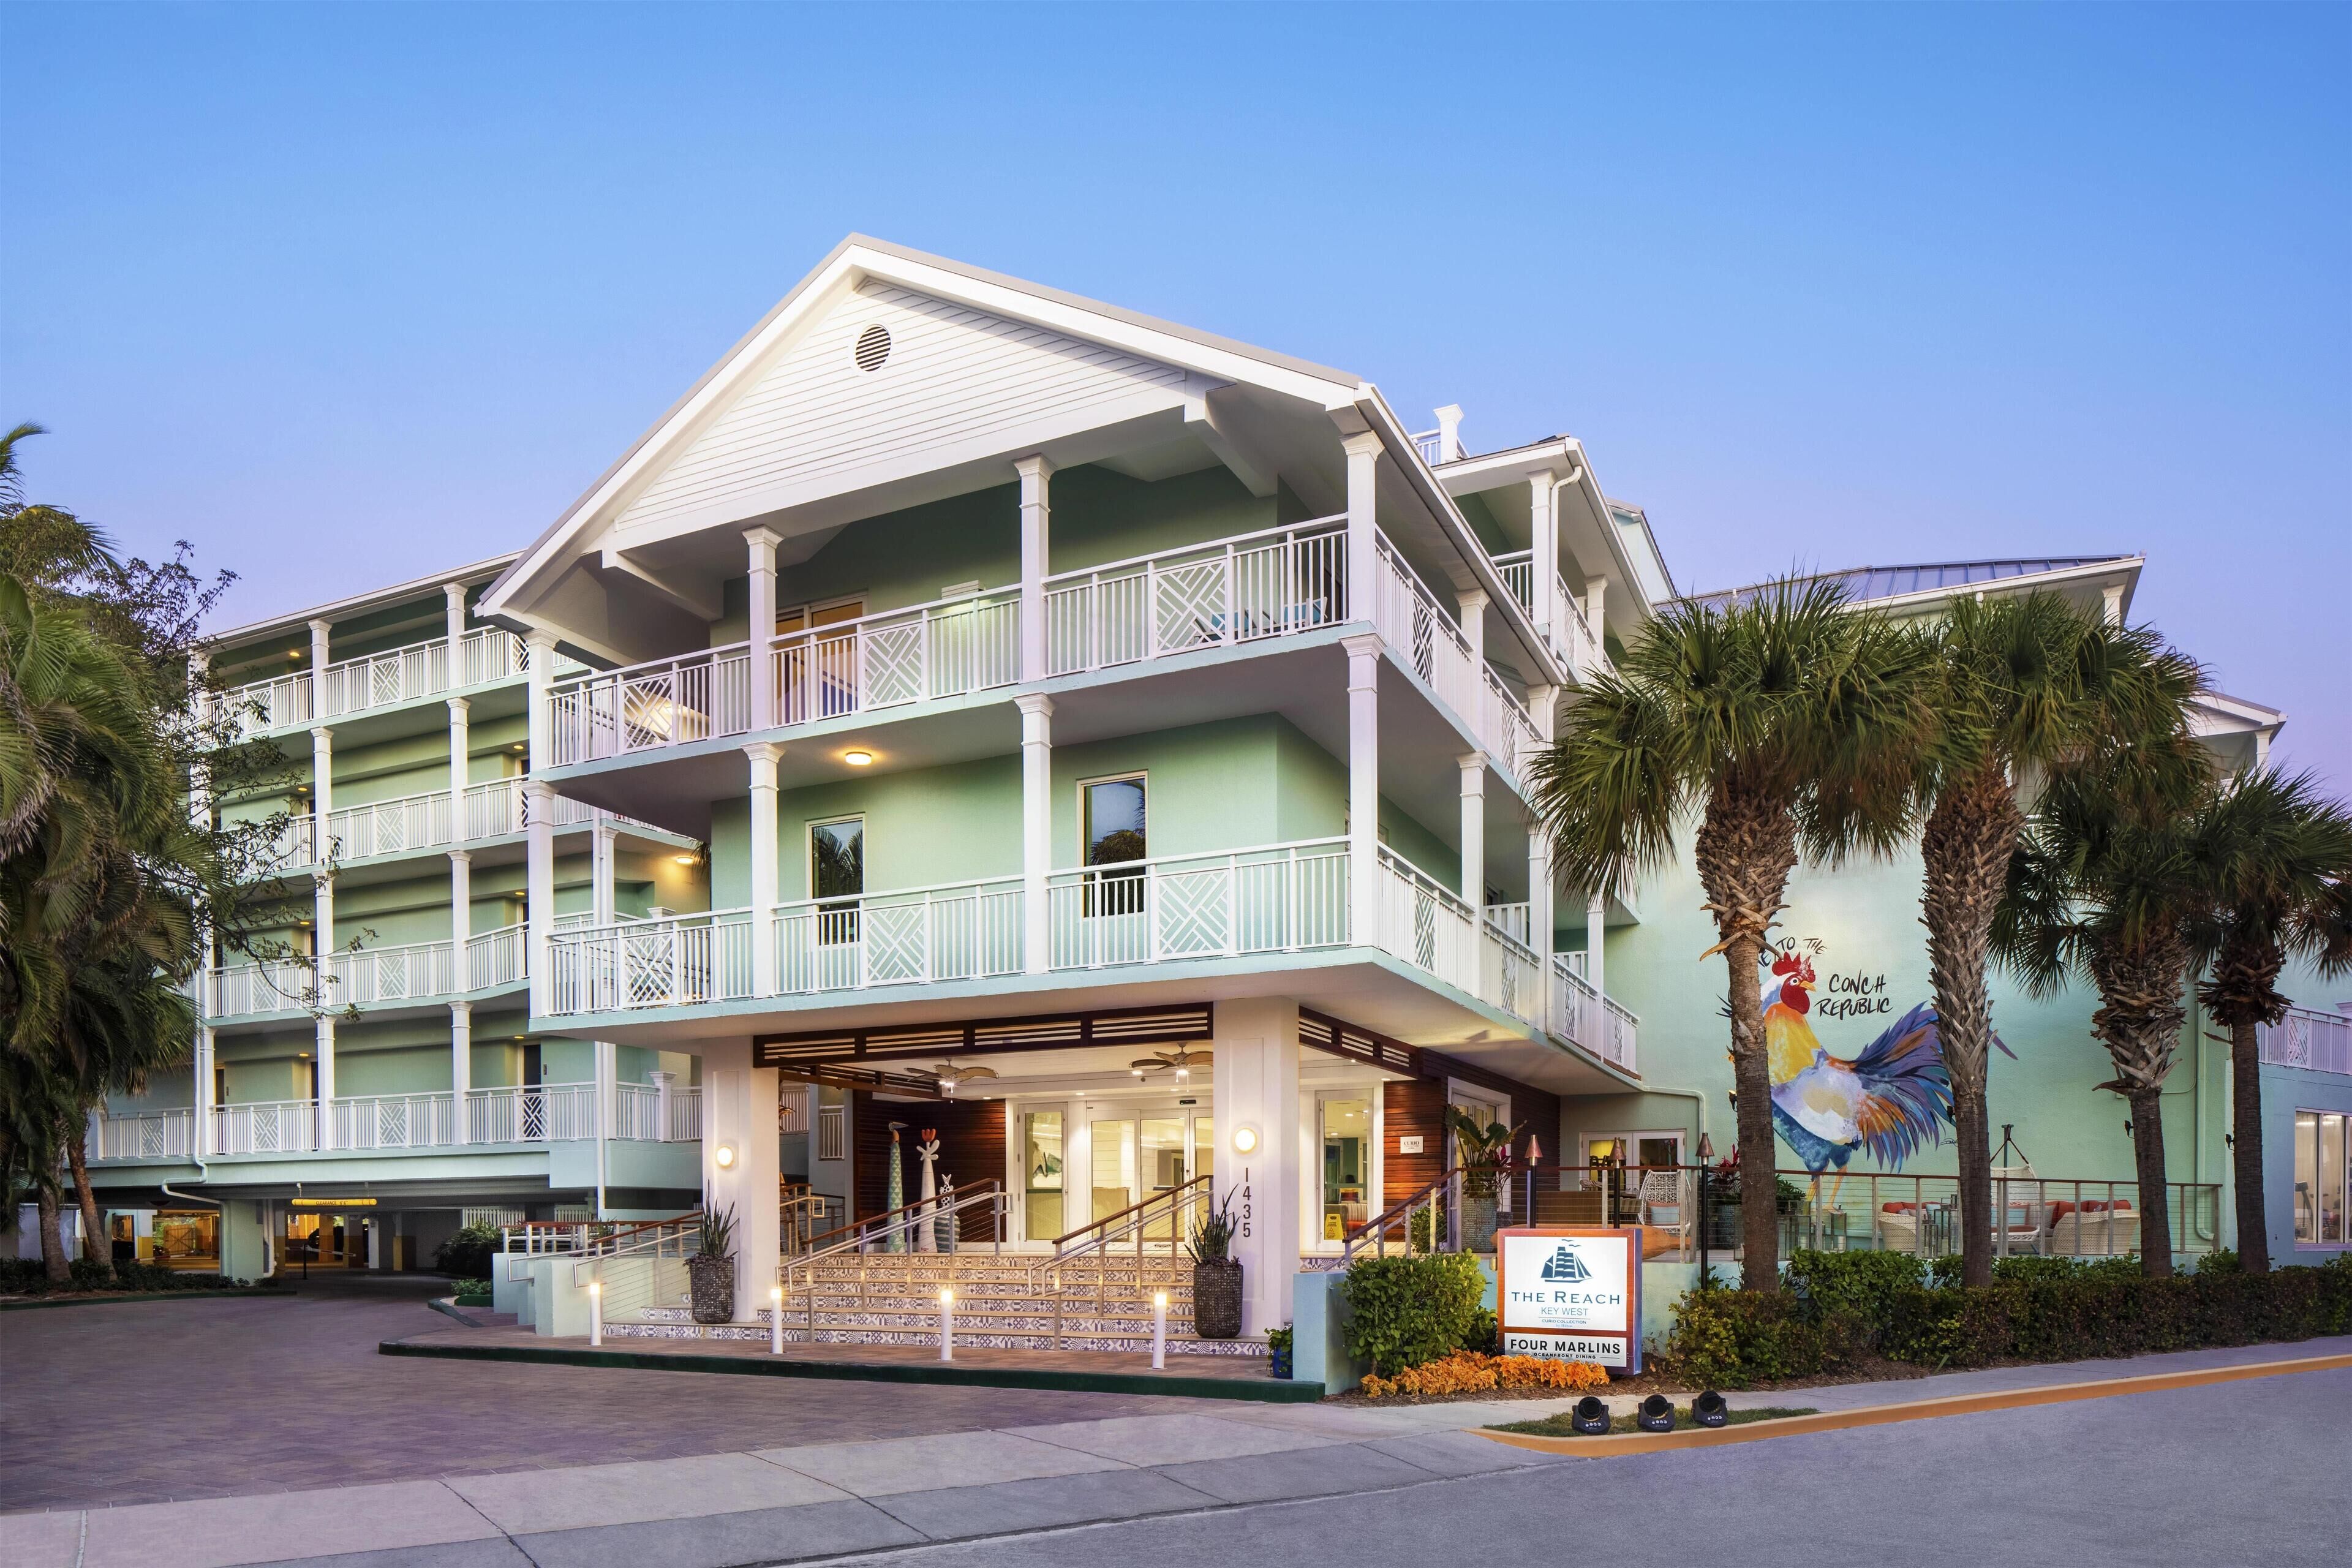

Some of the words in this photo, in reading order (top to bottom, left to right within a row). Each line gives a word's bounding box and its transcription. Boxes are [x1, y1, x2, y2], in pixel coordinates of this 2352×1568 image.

[1775, 937, 1795, 952] TO
[1803, 938, 1828, 954] THE
[1828, 969, 1887, 995] CONCH
[1813, 997, 1894, 1020] REPUBLIC
[1511, 1292, 1545, 1302] THE
[1555, 1291, 1620, 1304] REACH
[1562, 1308, 1588, 1316] WEST
[1510, 1339, 1547, 1351] FOUR
[1555, 1341, 1620, 1354] MARLINS
